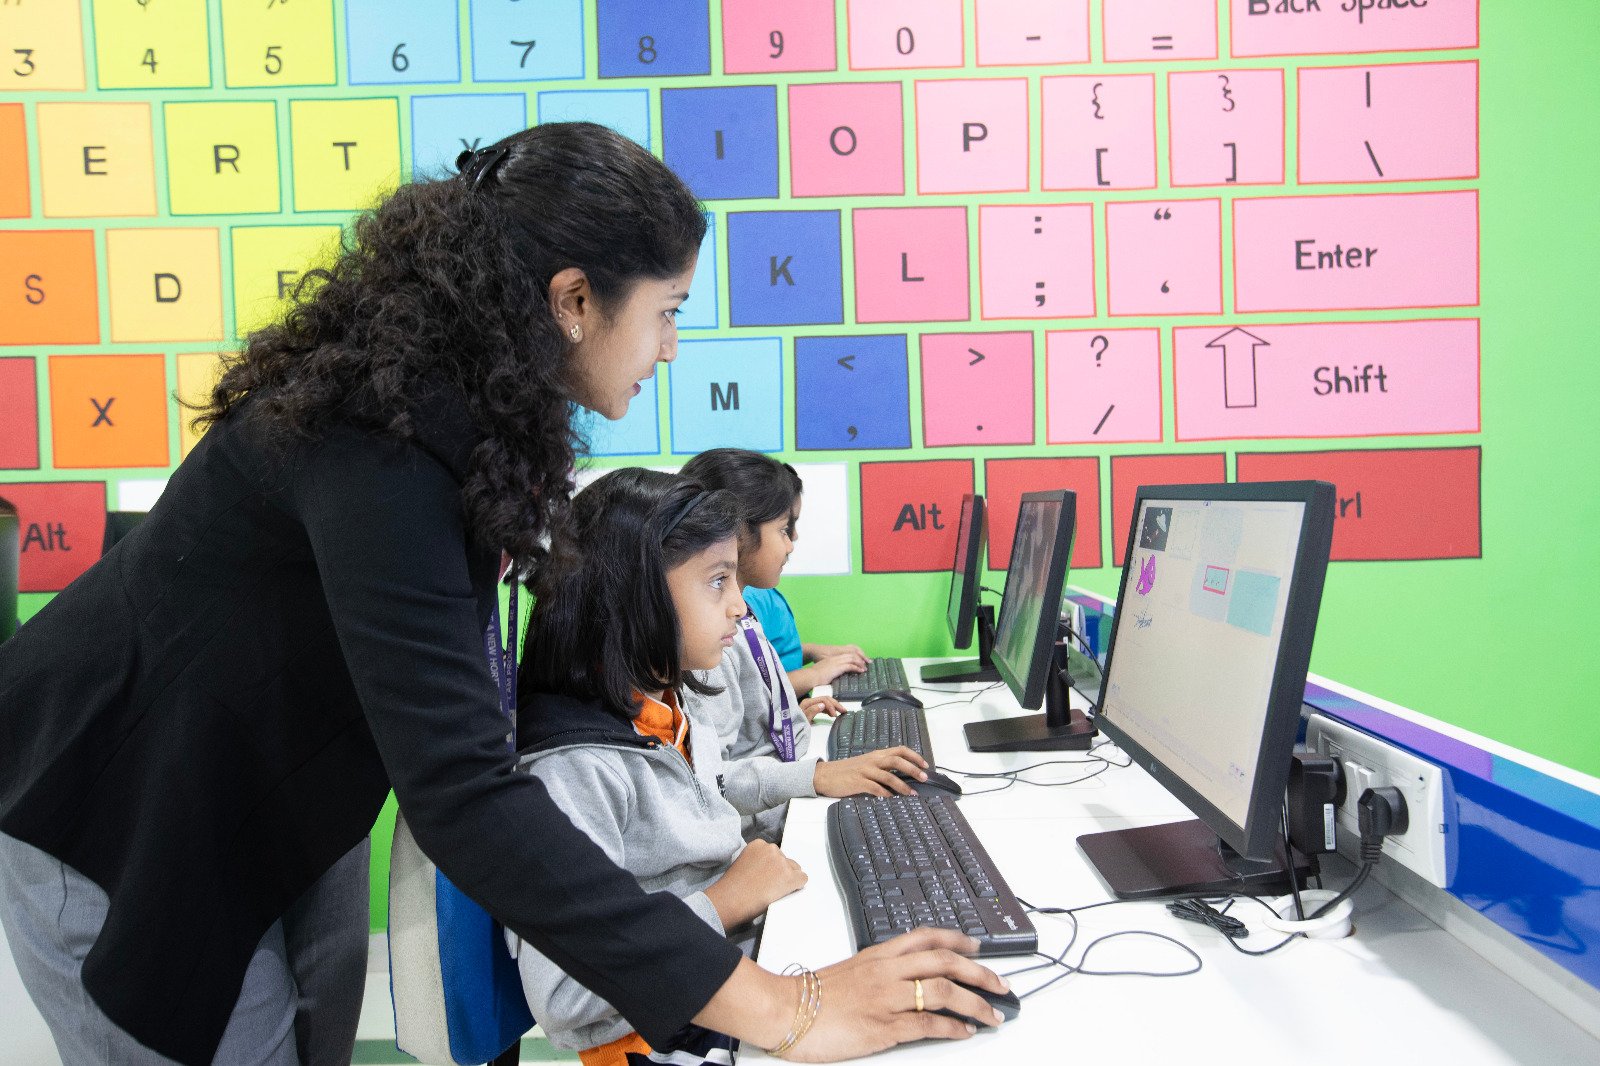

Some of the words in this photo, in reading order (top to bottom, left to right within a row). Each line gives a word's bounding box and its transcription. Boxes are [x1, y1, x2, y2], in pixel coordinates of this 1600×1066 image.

[391, 43, 410, 72] 6
[510, 40, 537, 68] 7
[637, 35, 659, 65] 8
[769, 30, 785, 59] 9
[1151, 35, 1174, 51] =
[13, 48, 35, 77] 3
[141, 48, 158, 74] 4
[264, 46, 283, 75] 5
[1091, 82, 1105, 119] {
[713, 130, 725, 160] I
[829, 125, 858, 157] O
[962, 122, 988, 152] P
[82, 145, 108, 176] E
[213, 144, 240, 174] R
[332, 141, 358, 171] T
[1095, 147, 1111, 186] [
[1223, 142, 1237, 183] ]
[1364, 140, 1384, 178] \
[1034, 215, 1043, 235] :
[901, 252, 925, 283] L
[1294, 239, 1378, 271] Enter
[277, 270, 299, 300] F
[769, 255, 797, 287] K
[24, 273, 46, 305] S
[154, 272, 182, 303] D
[1034, 281, 1046, 308] ;
[837, 354, 856, 371] <
[967, 347, 986, 367] >
[1090, 334, 1109, 367] ?
[1313, 364, 1388, 396] Shift
[710, 381, 740, 412] M
[90, 397, 115, 428] X
[1092, 404, 1115, 435] /
[976, 424, 984, 432] .
[892, 503, 946, 532] Alt
[1335, 491, 1362, 518] rl
[21, 522, 72, 552] Alt
[487, 633, 498, 656] NEW
